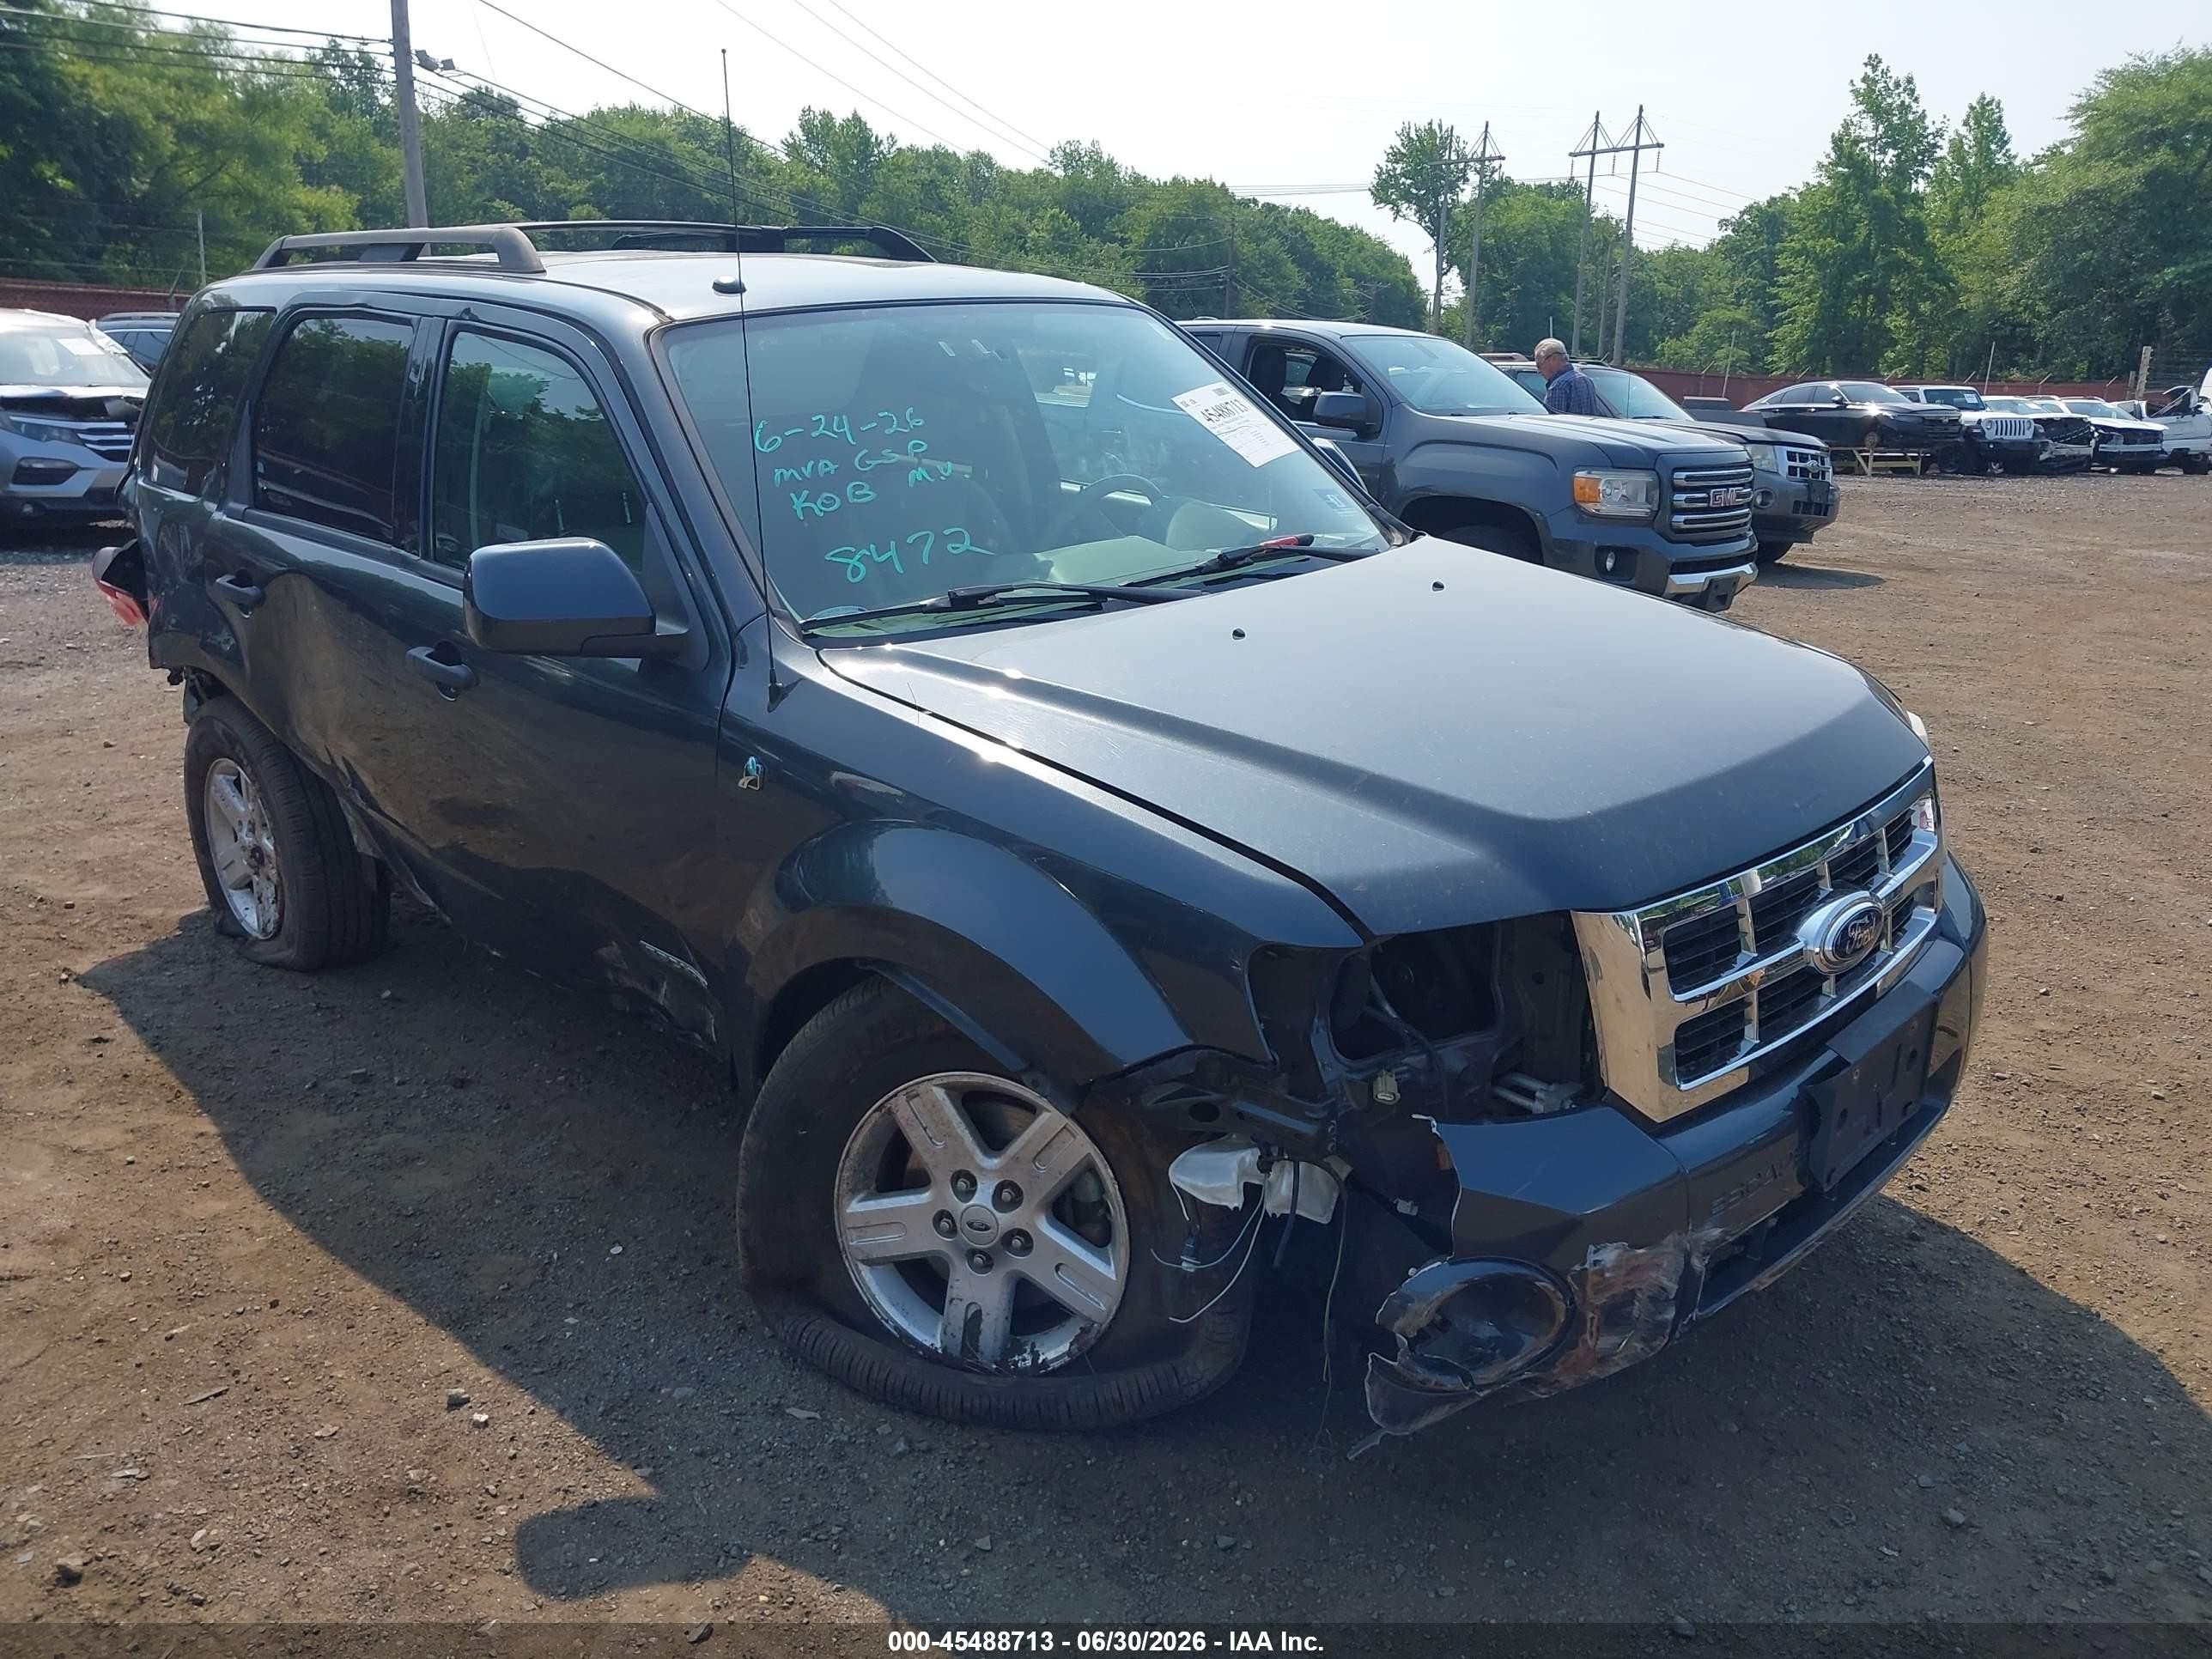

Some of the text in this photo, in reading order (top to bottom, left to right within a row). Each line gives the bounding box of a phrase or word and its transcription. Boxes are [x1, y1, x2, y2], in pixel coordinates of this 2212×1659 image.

[755, 407, 926, 453] 6-24-26
[1200, 398, 1249, 423] 45488713
[789, 481, 877, 520] KOB
[1710, 487, 1747, 507] GMC
[824, 527, 996, 583] 8472
[1846, 914, 1877, 955] Ford
